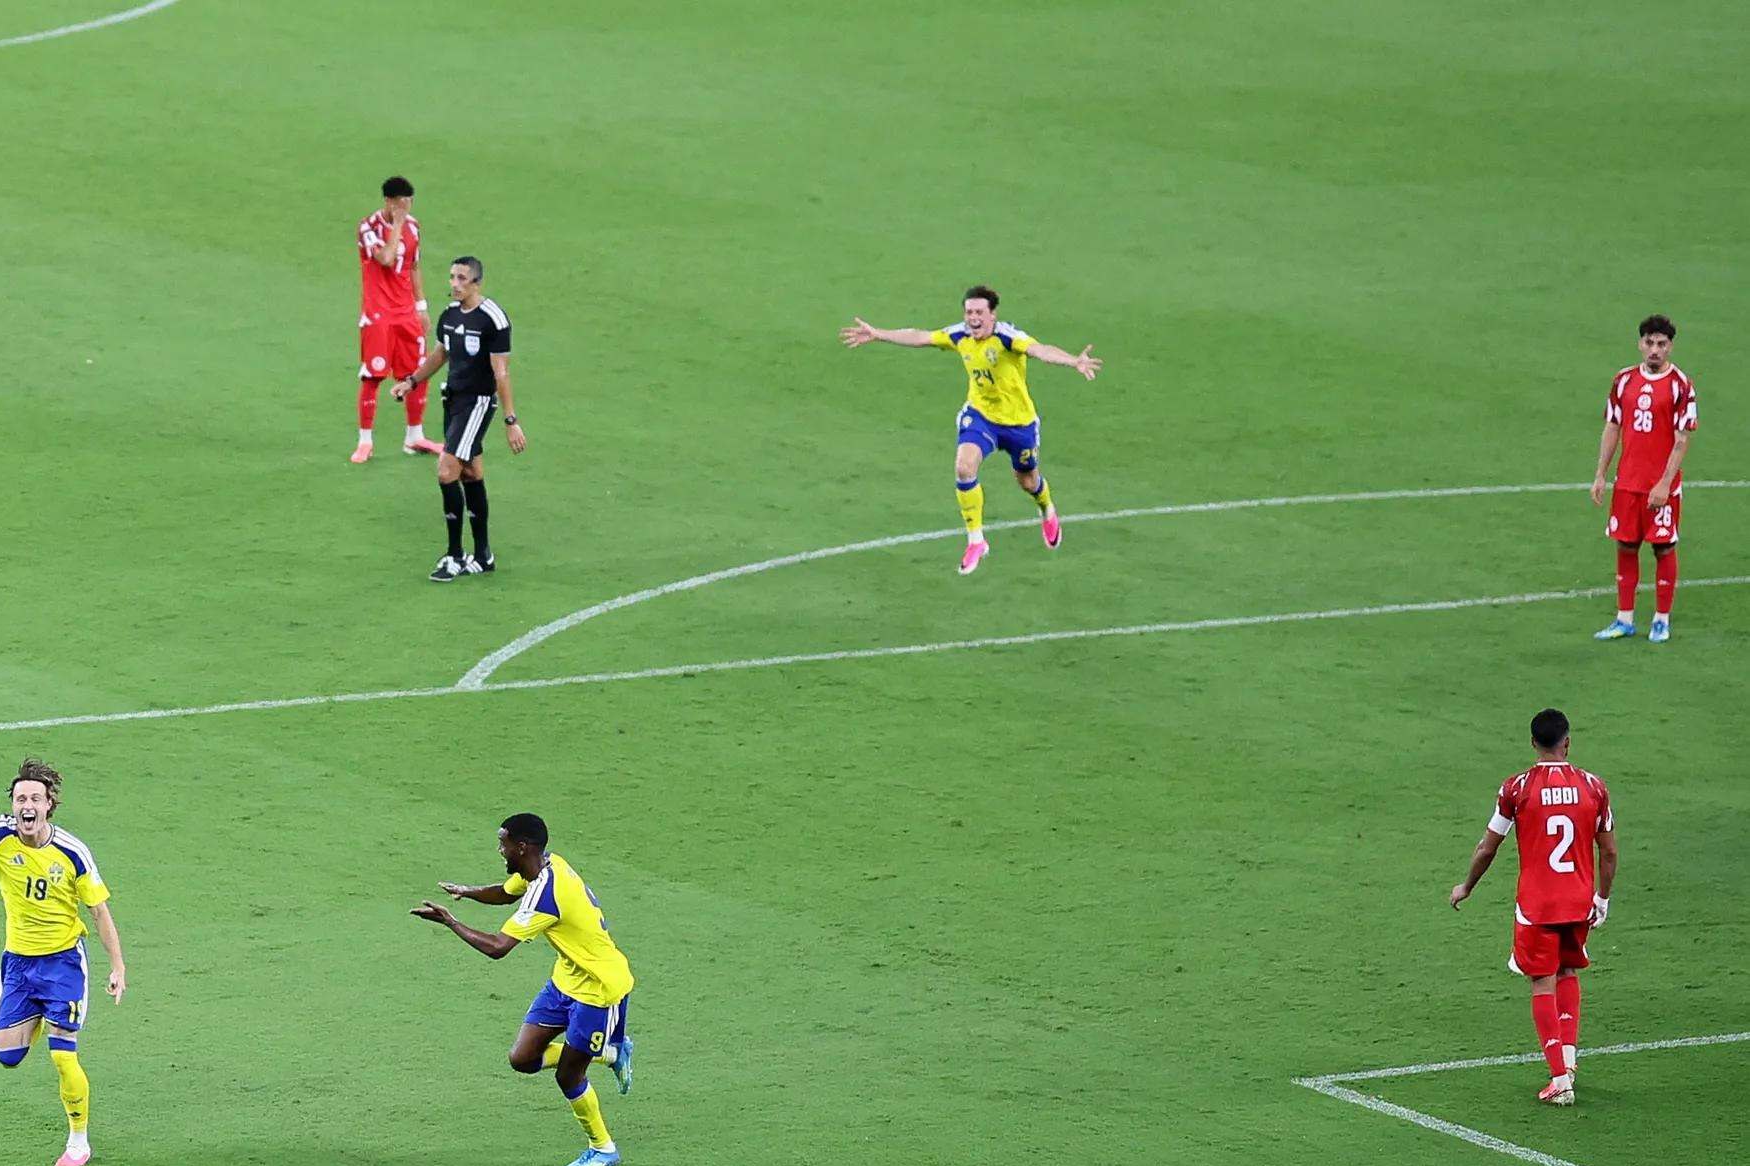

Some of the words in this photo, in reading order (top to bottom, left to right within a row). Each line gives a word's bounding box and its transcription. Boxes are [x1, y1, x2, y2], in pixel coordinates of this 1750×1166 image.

[973, 369, 995, 387] 24
[1633, 409, 1653, 433] 26
[1654, 505, 1672, 527] 26
[1541, 786, 1579, 806] ABDI
[1546, 814, 1575, 873] 2
[25, 876, 48, 901] 19
[589, 1031, 604, 1051] 9
